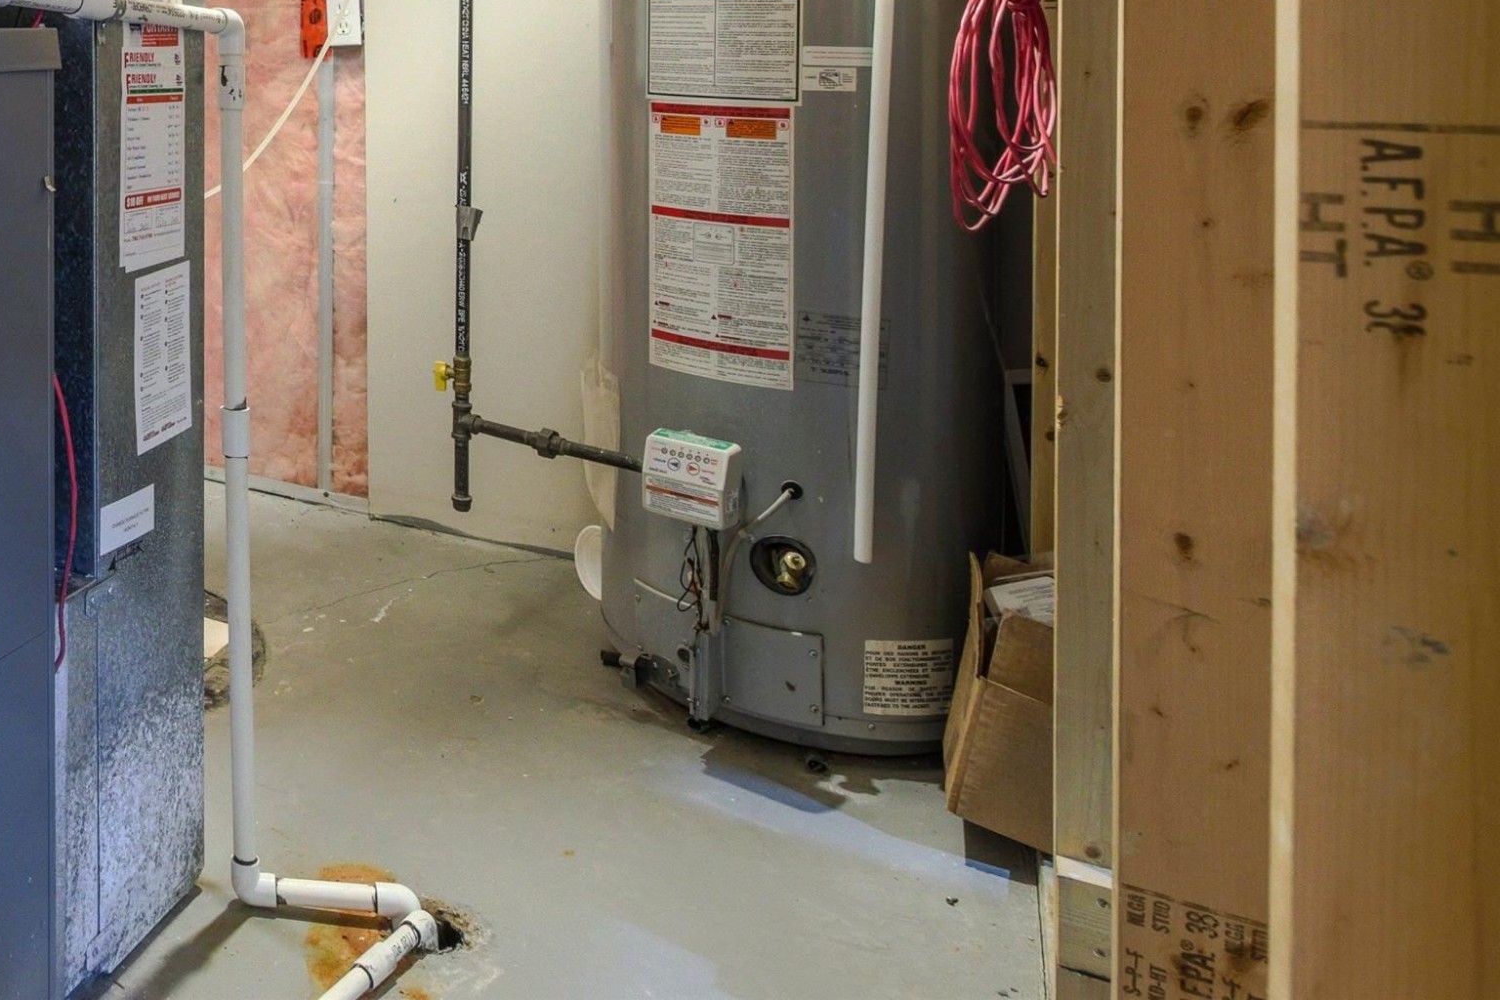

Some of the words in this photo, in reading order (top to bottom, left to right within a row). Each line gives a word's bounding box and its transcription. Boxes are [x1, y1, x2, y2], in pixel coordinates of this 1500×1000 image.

[124, 52, 155, 69] FRIENDLY
[125, 73, 157, 95] FRIENDLY
[1298, 191, 1348, 279] HT
[1126, 893, 1146, 927] NLGA
[1151, 900, 1171, 935] STUD
[1185, 910, 1220, 940] 38
